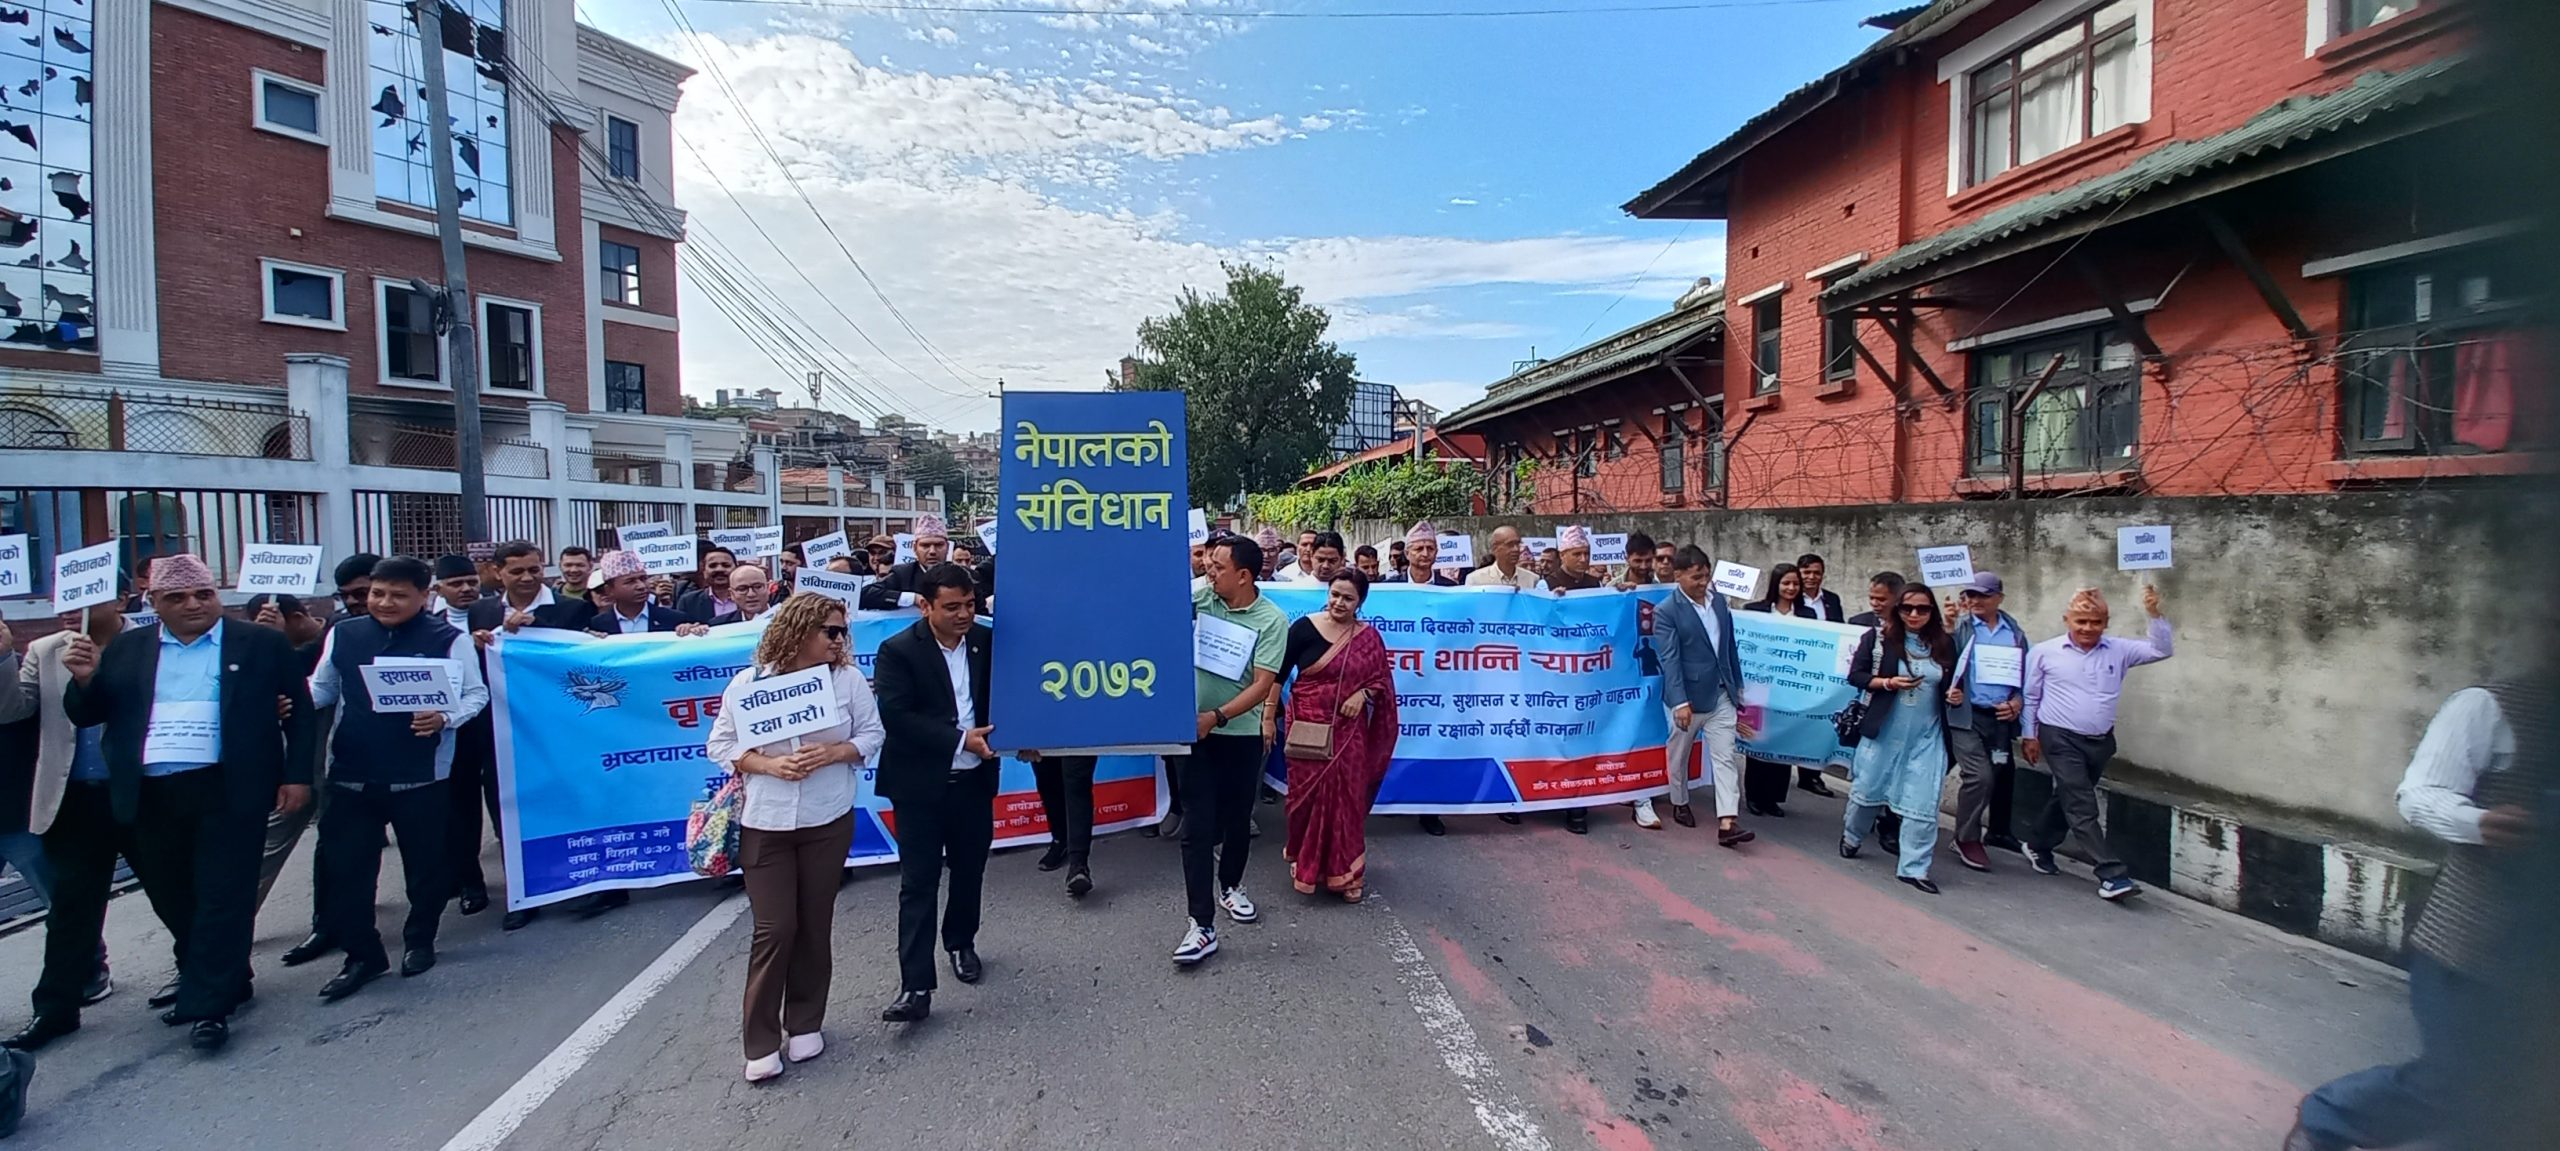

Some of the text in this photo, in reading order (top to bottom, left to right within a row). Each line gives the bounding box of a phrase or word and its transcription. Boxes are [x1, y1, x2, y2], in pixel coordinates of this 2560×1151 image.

[1014, 420, 1174, 468] नेपालको
[1015, 478, 1173, 532] संविधान
[1421, 617, 1475, 635] दिवसको
[1551, 622, 1610, 638] आयोजित
[1434, 644, 1522, 671] शान्ति
[378, 670, 433, 686] सुशासन
[1040, 659, 1157, 700] २०७२
[377, 693, 422, 706] कायम
[1453, 694, 1505, 712] सुशासन
[1510, 694, 1520, 707] र
[1525, 690, 1570, 708] शान्ति
[1575, 690, 1602, 710] हाम्रो
[1605, 686, 1642, 704] चाहना
[749, 716, 783, 736] रक्षा
[1437, 718, 1485, 738] रक्षाको
[1534, 722, 1583, 737] कामना
[653, 826, 671, 838] गते
